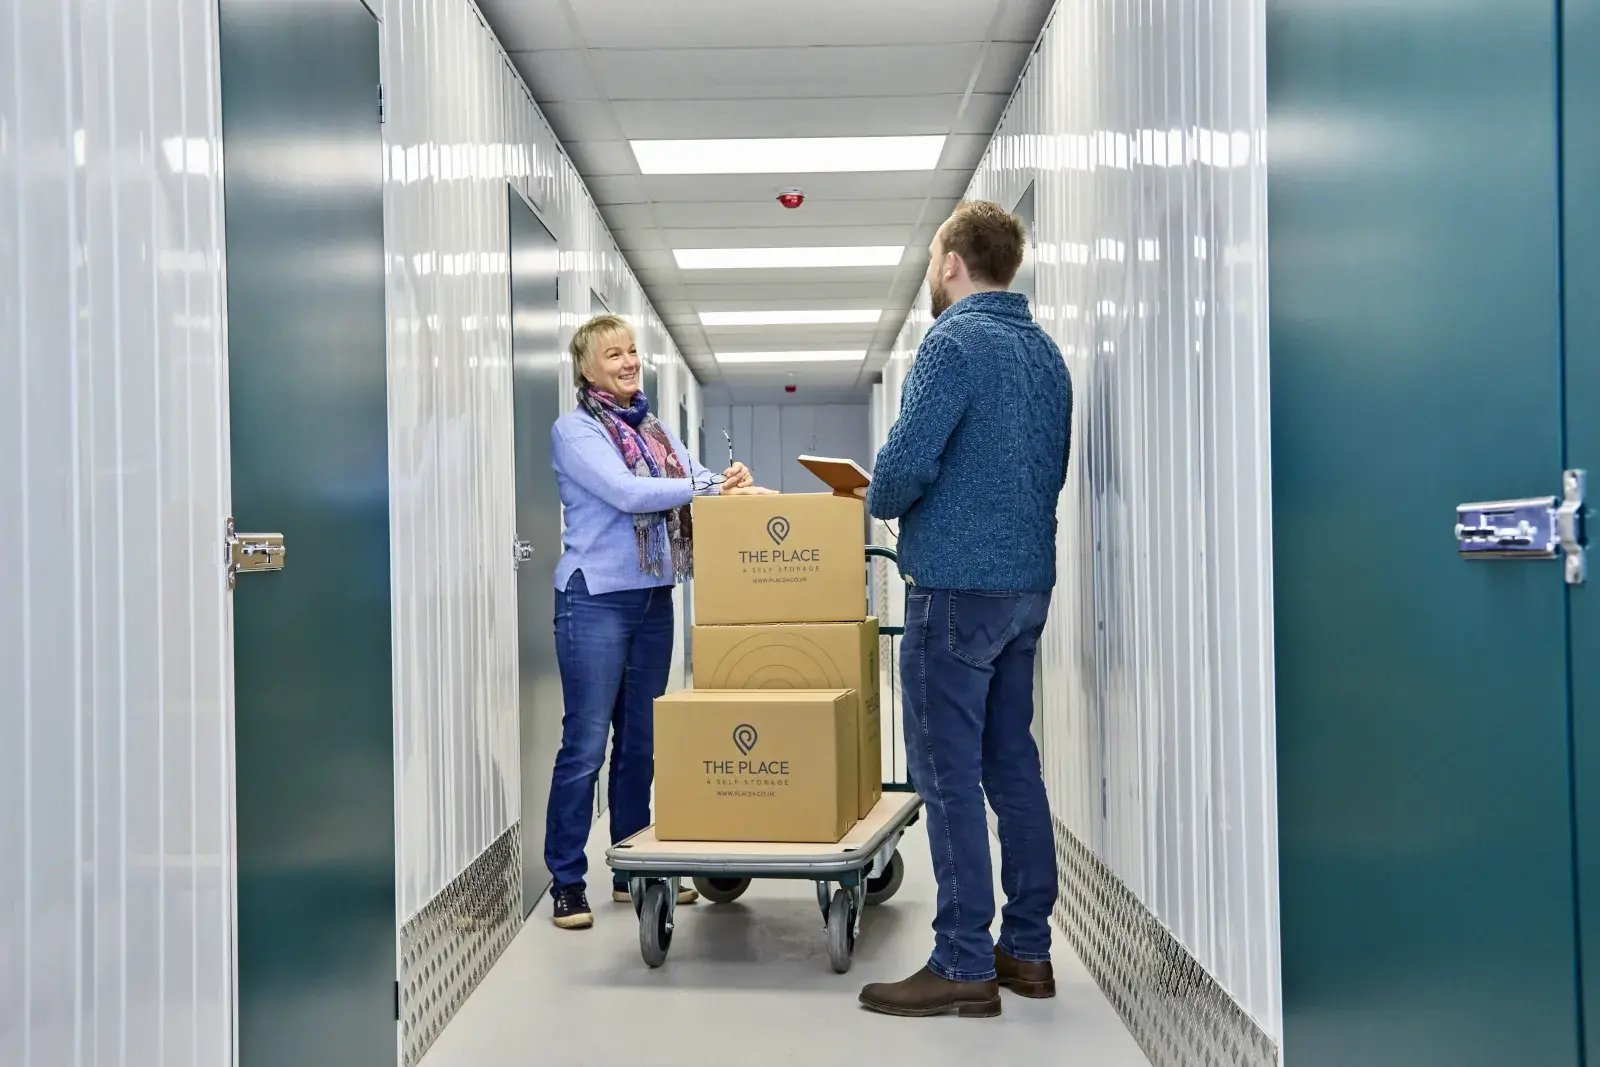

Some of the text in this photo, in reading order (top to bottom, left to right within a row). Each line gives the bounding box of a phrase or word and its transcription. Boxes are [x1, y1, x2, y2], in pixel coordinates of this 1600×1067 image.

[738, 549, 820, 564] THE PLACE
[702, 760, 790, 774] THE PLACE
